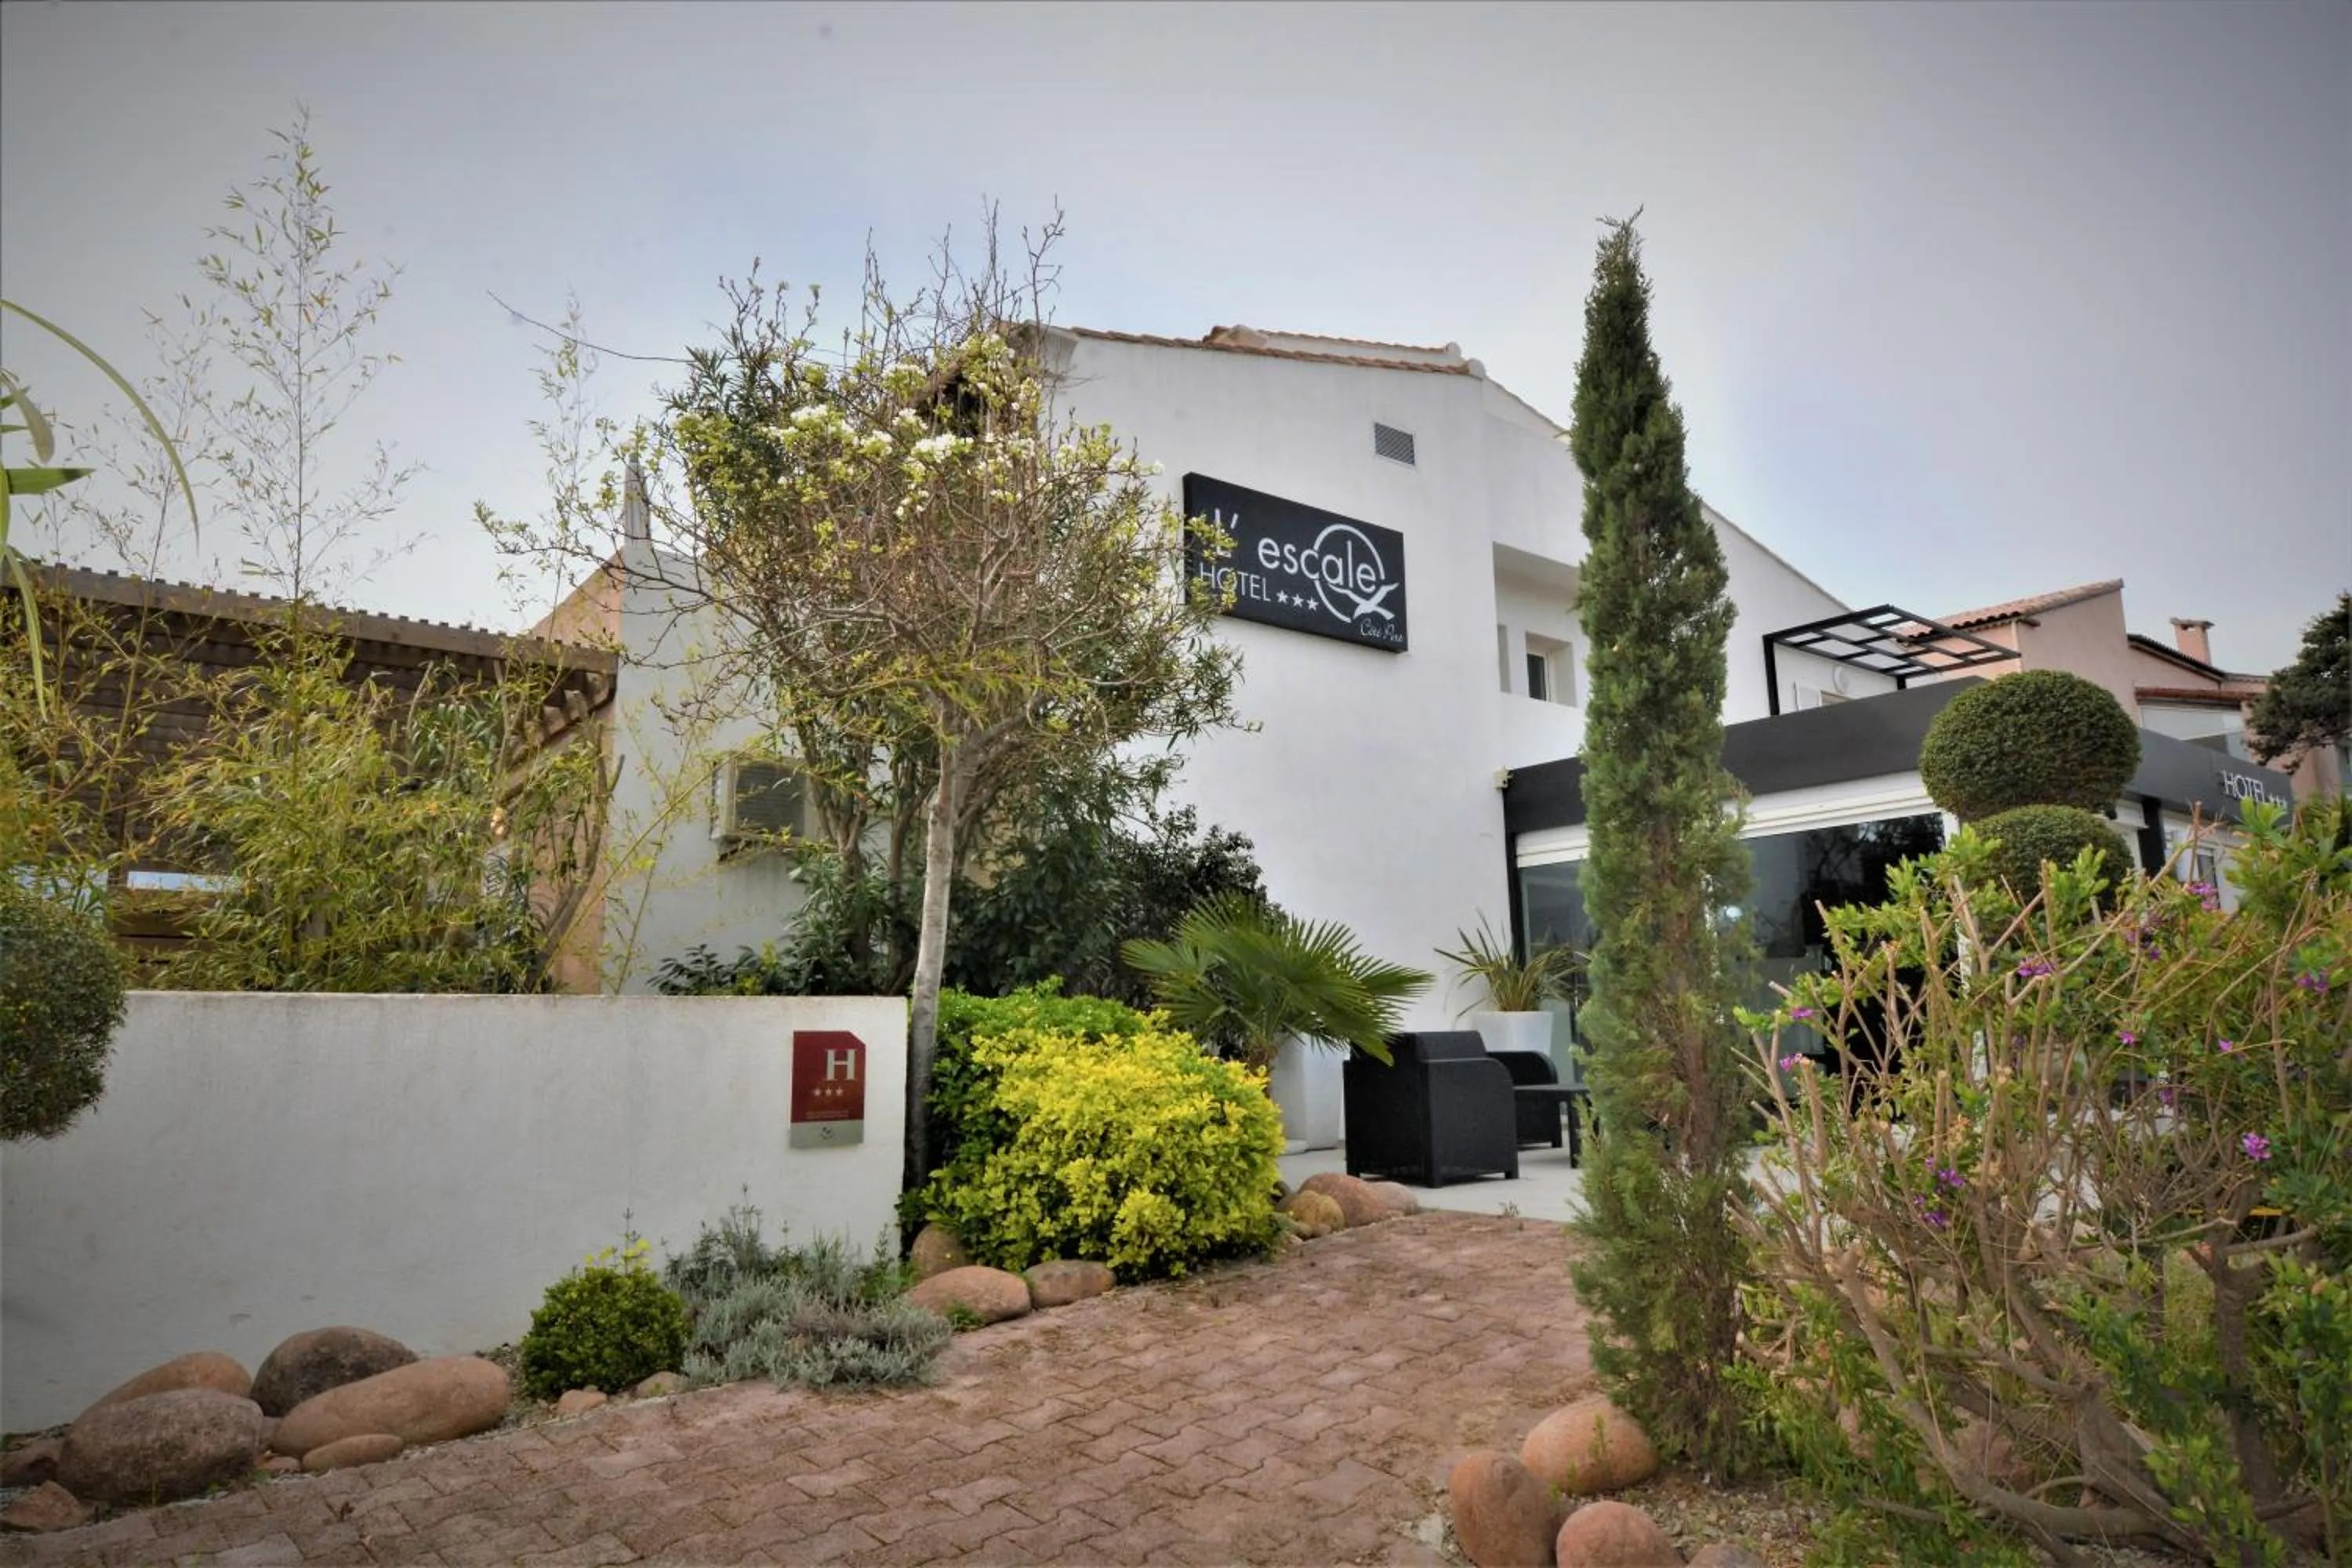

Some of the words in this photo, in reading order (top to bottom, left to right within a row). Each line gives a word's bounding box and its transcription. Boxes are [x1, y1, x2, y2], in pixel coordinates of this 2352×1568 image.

[1199, 562, 1272, 602] HOTEL
[1257, 536, 1377, 594] escale
[826, 1049, 856, 1080] H
